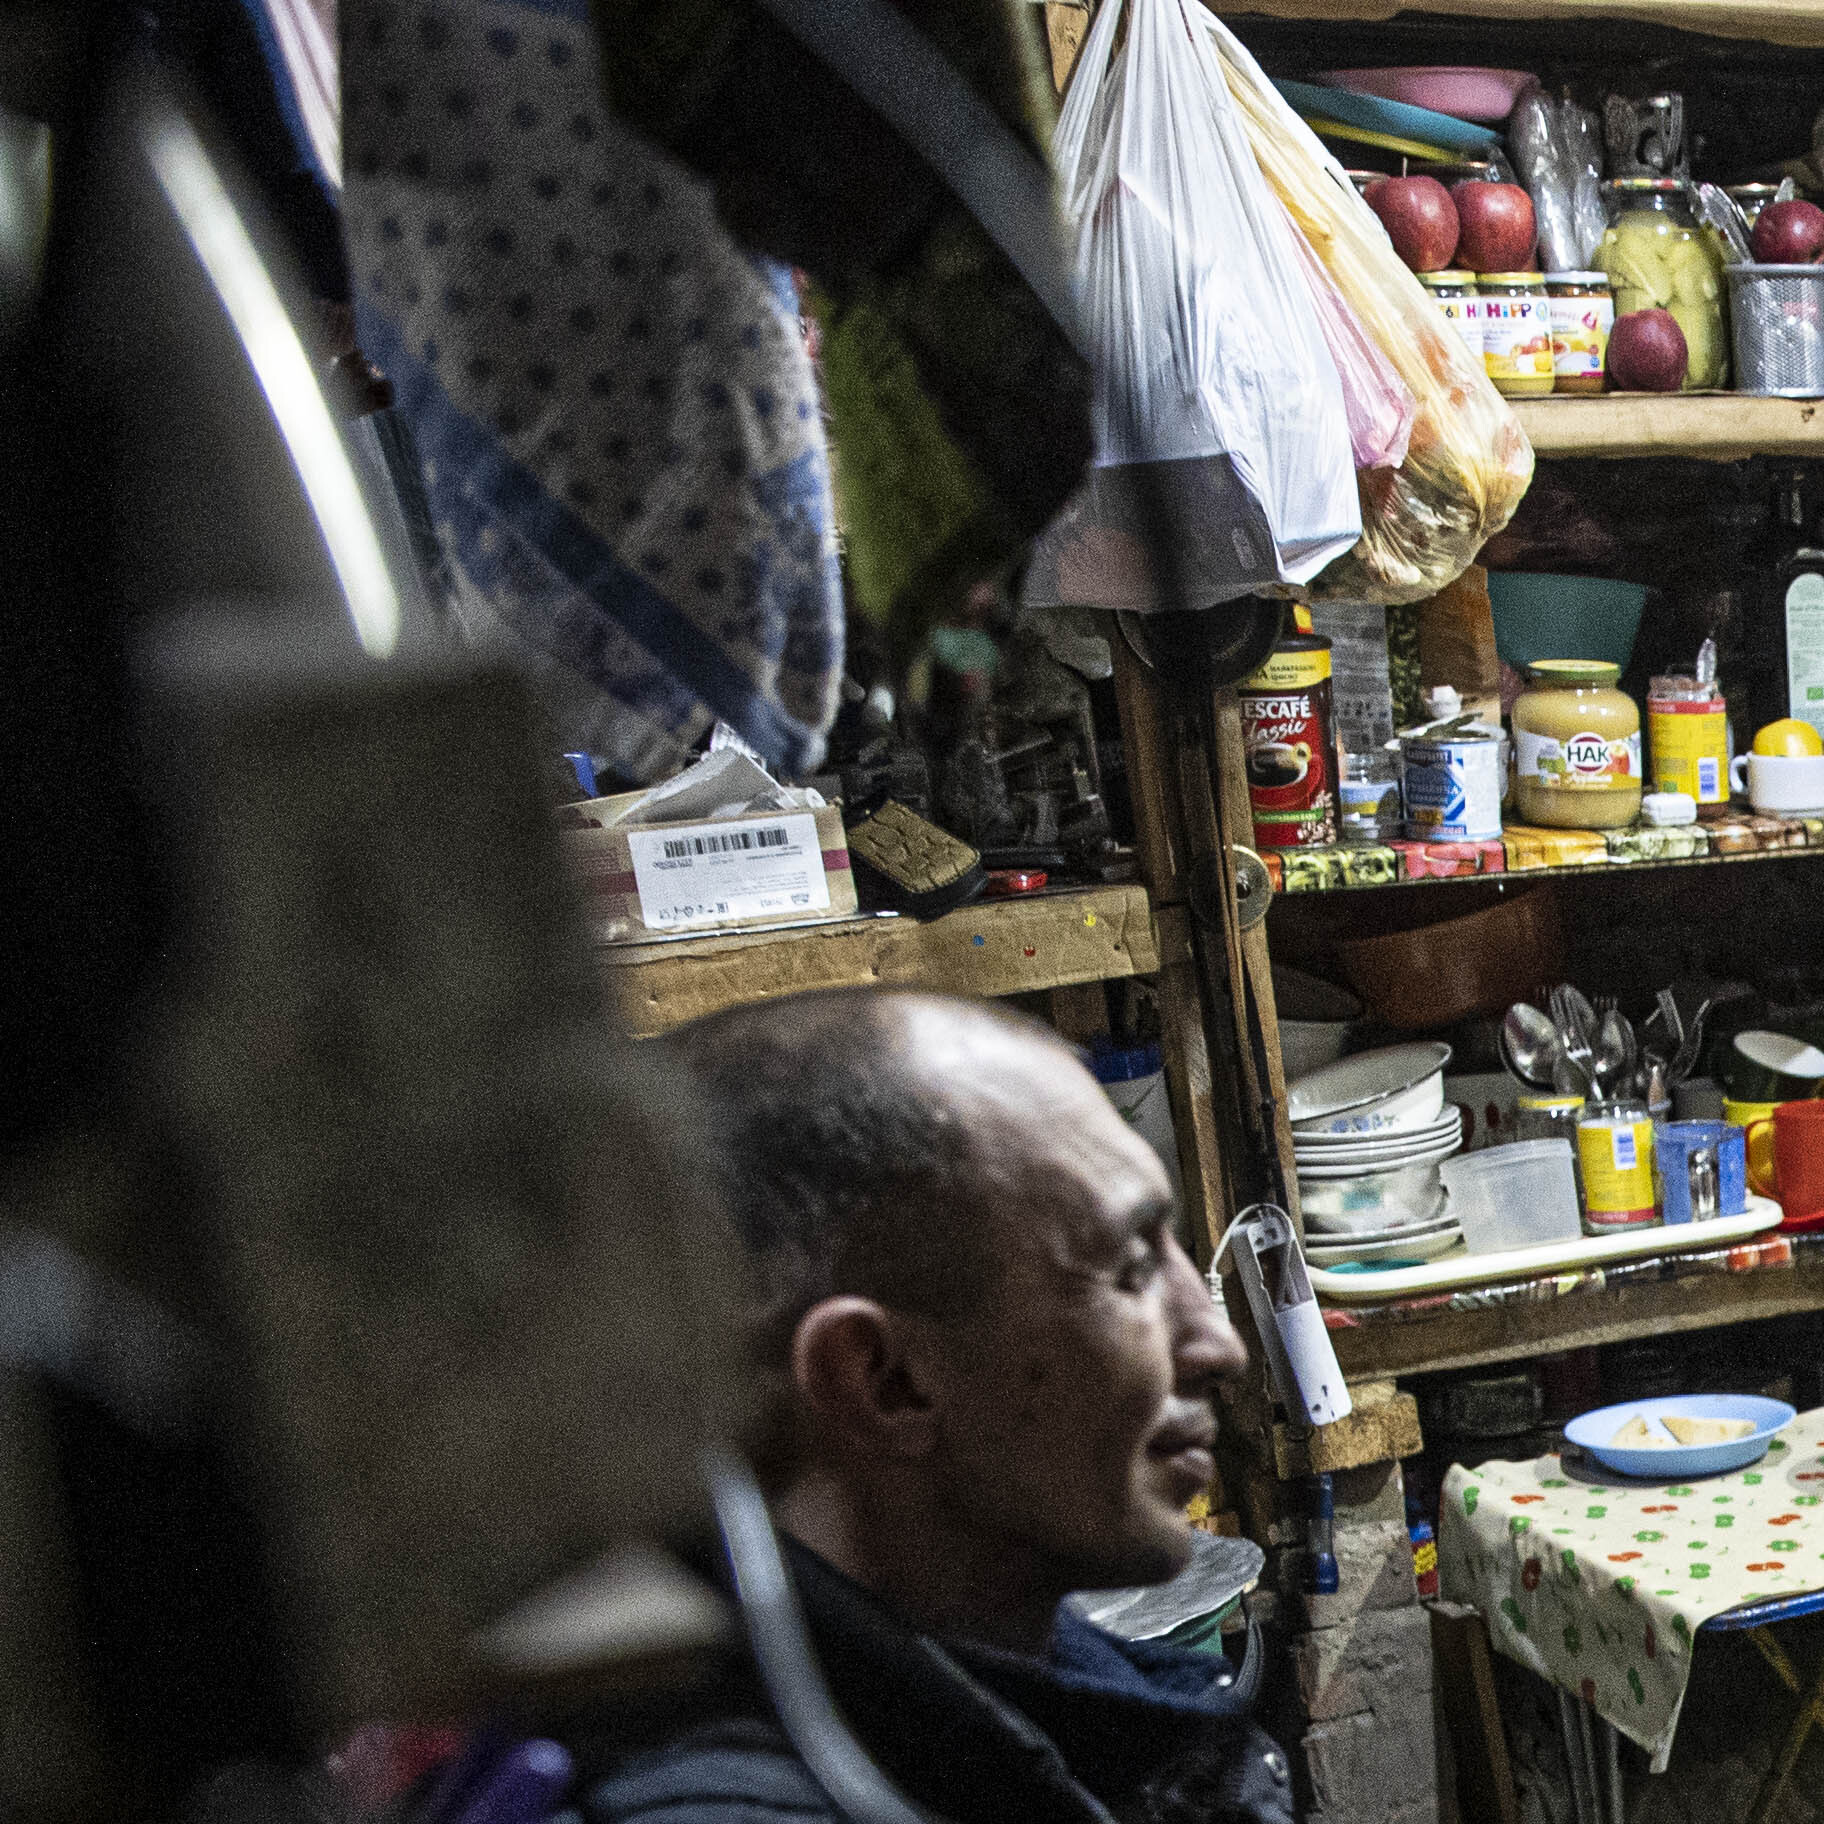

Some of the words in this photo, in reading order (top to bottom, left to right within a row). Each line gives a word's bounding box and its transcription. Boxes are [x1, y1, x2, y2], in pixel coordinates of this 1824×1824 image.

[1241, 695, 1312, 719] ESCAFÉ
[1248, 718, 1307, 741] lassic
[1567, 746, 1609, 762] HAK
